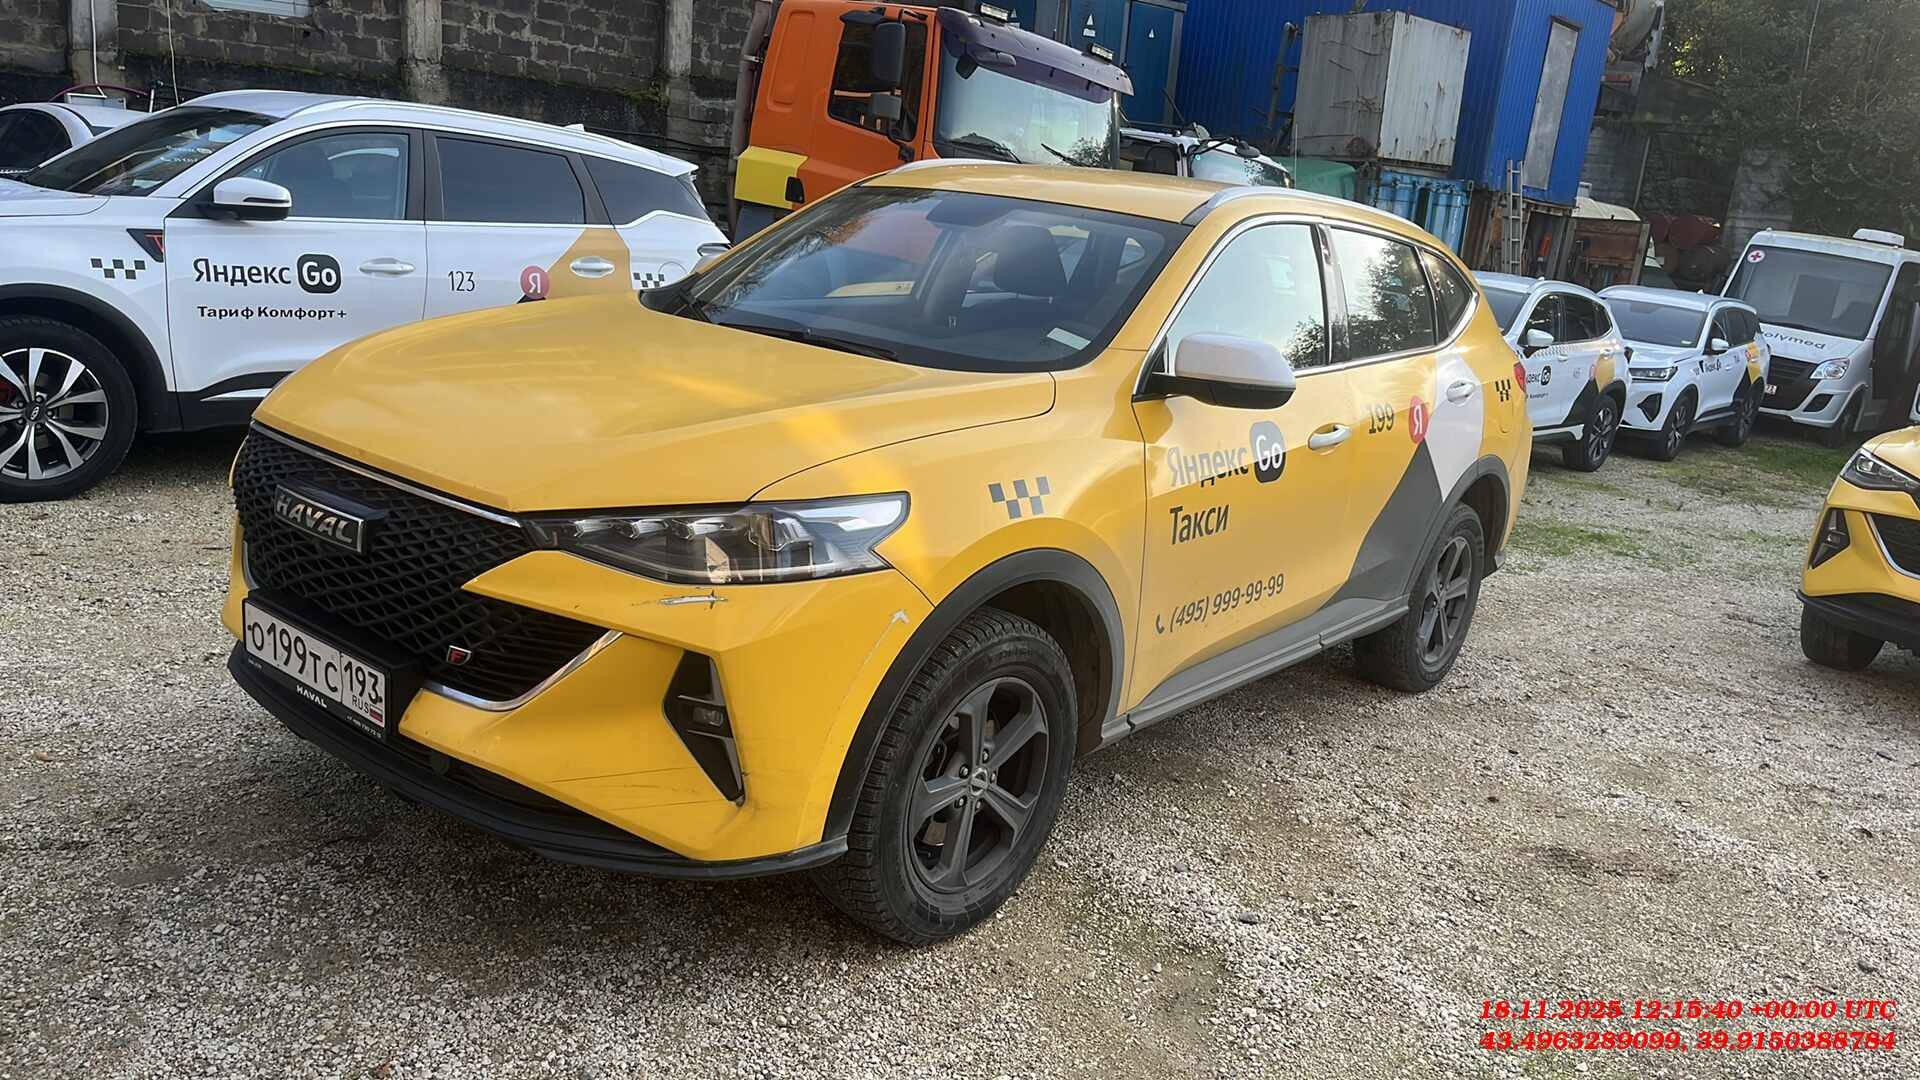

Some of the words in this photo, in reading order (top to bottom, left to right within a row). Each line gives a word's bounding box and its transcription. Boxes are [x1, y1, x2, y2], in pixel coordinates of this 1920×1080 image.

[193, 258, 291, 286] Яндекс
[301, 260, 338, 288] Go
[448, 271, 475, 292] 123
[528, 272, 541, 294] Я
[197, 306, 254, 320] Тариф
[1367, 402, 1394, 434] 199
[1413, 404, 1423, 436] Я
[1167, 446, 1249, 488] Яндекс
[1254, 432, 1284, 474] Go
[276, 494, 353, 544] HAVAL
[1169, 504, 1230, 546] Такси
[1169, 596, 1210, 633] (495)
[1211, 573, 1285, 616] 999-99-99
[296, 684, 328, 709] HAVAL
[343, 660, 380, 705] 193
[351, 694, 370, 714] RUS
